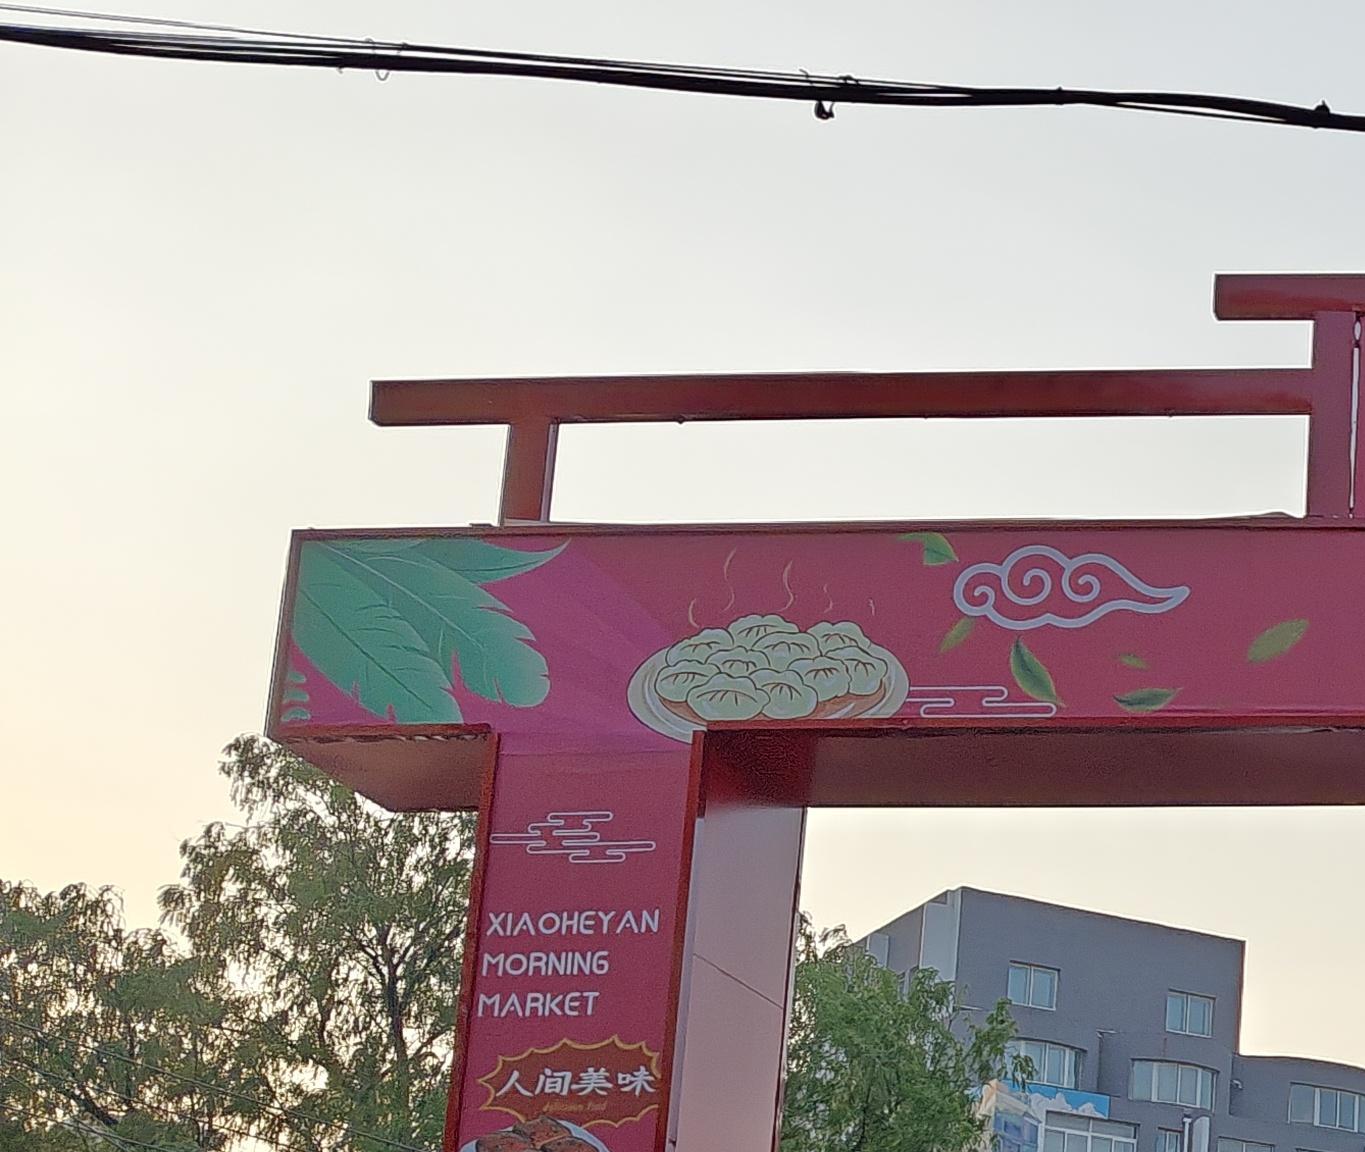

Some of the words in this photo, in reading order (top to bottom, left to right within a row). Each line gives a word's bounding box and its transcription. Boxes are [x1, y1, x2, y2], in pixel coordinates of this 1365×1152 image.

[486, 908, 661, 937] XIAOHEYAN
[481, 950, 610, 978] MORNING
[477, 991, 601, 1019] MARKET
[495, 1065, 657, 1097] 人间美味
